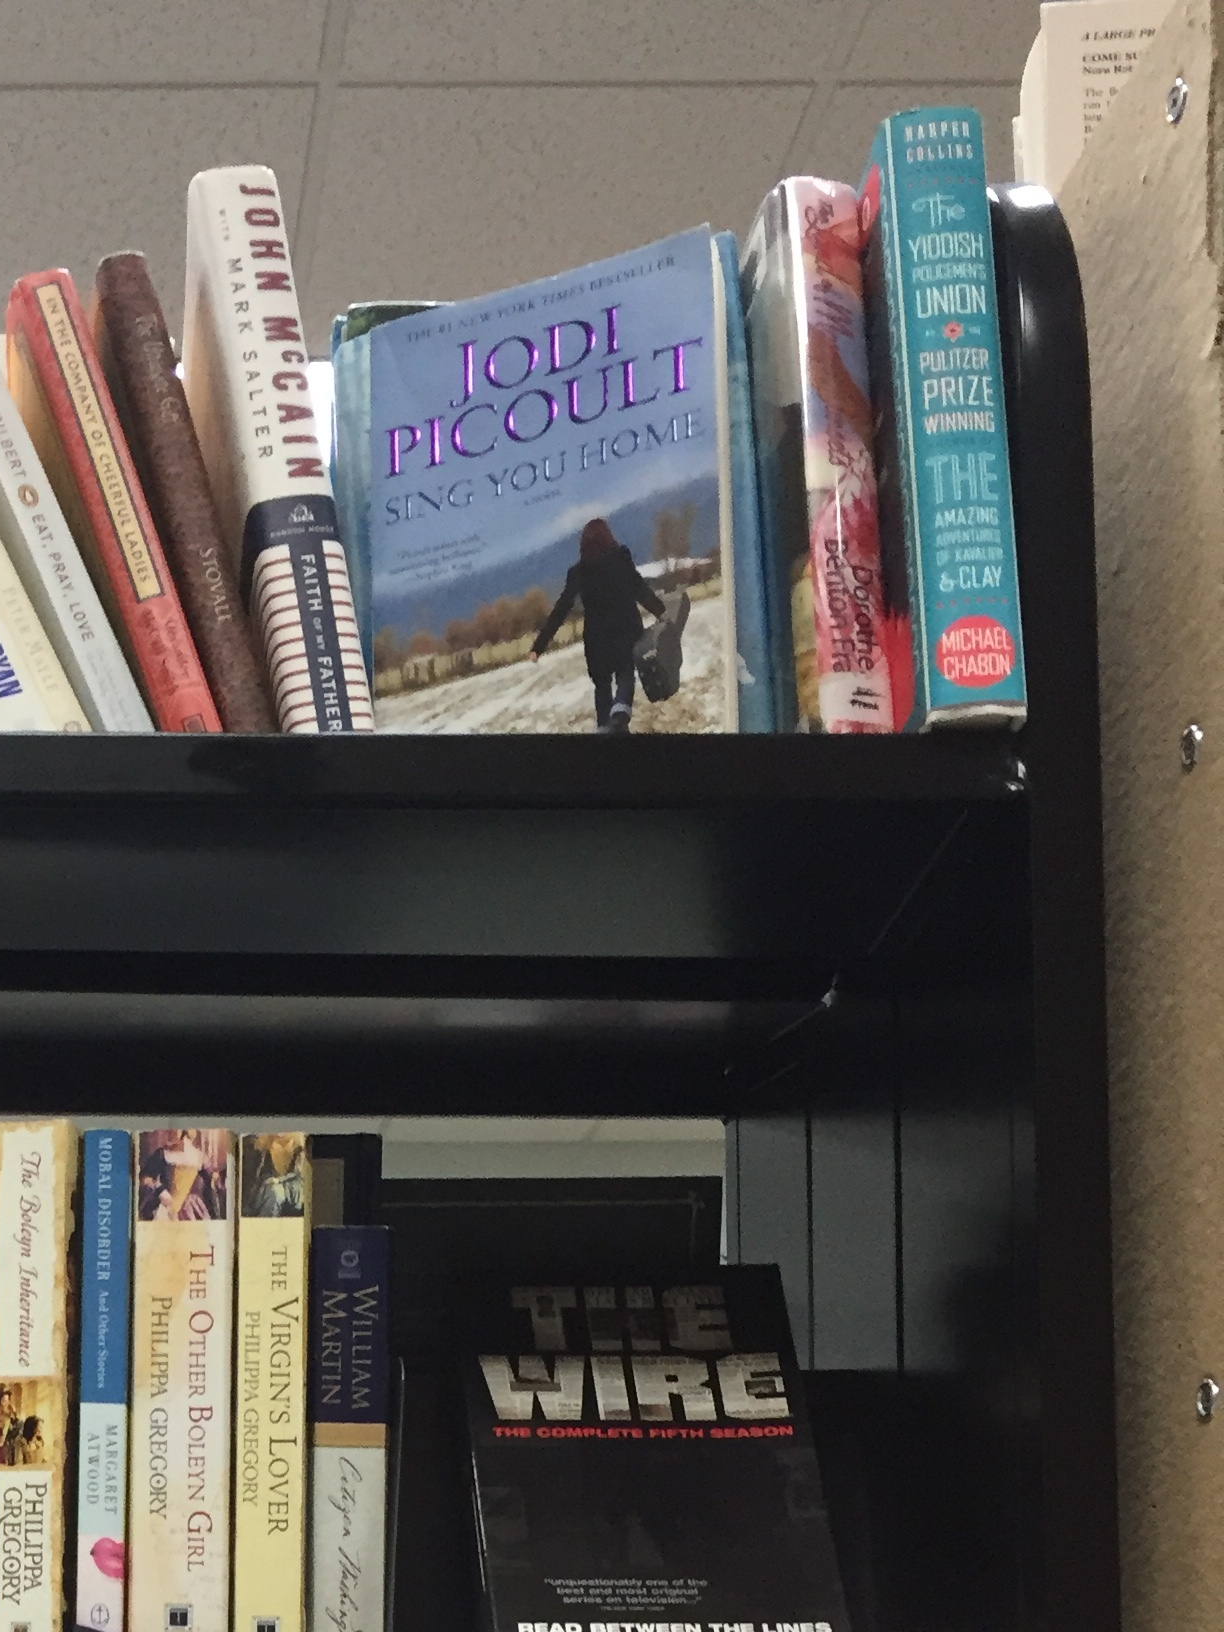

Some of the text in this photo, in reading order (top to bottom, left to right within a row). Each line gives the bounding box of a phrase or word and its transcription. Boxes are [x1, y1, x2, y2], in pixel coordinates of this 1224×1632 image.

[238, 183, 292, 293] JOHN
[907, 231, 985, 264] YIDDISH
[914, 283, 988, 320] UNION
[226, 257, 274, 460] MARK SALTER
[448, 302, 623, 409] JODI
[919, 347, 990, 375] PULITZER
[383, 335, 704, 480] PICOULT
[922, 374, 995, 411] PRIZE
[922, 410, 996, 436] WINNING
[384, 407, 708, 527] SING YOU HOME
[925, 451, 999, 505] THE
[934, 505, 1000, 530] AMAZING
[300, 552, 325, 613] FAITH
[312, 616, 325, 632] OF
[941, 625, 1013, 653] MICHAEL
[942, 652, 1012, 681] CHABON
[320, 1288, 349, 1405] MARTIN
[350, 1283, 380, 1410] WILLIAM
[510, 1285, 733, 1352] THE
[148, 1295, 174, 1521] PHILIPPA GREGORY
[186, 1244, 216, 1573] THE OTHER BOLEYN GIRL
[241, 1309, 261, 1507] PHILIPPA GREGORY
[266, 1246, 300, 1537] THE VIRGIN'S LOVER
[478, 1351, 792, 1422] WIRE
[492, 1426, 795, 1439] THE COMPLETE FIFTH SEASON
[86, 1431, 101, 1506] ATWOOD
[103, 1423, 119, 1515] MARGARET
[22, 1481, 49, 1592] PHILIPPA
[562, 1595, 623, 1605] series on
